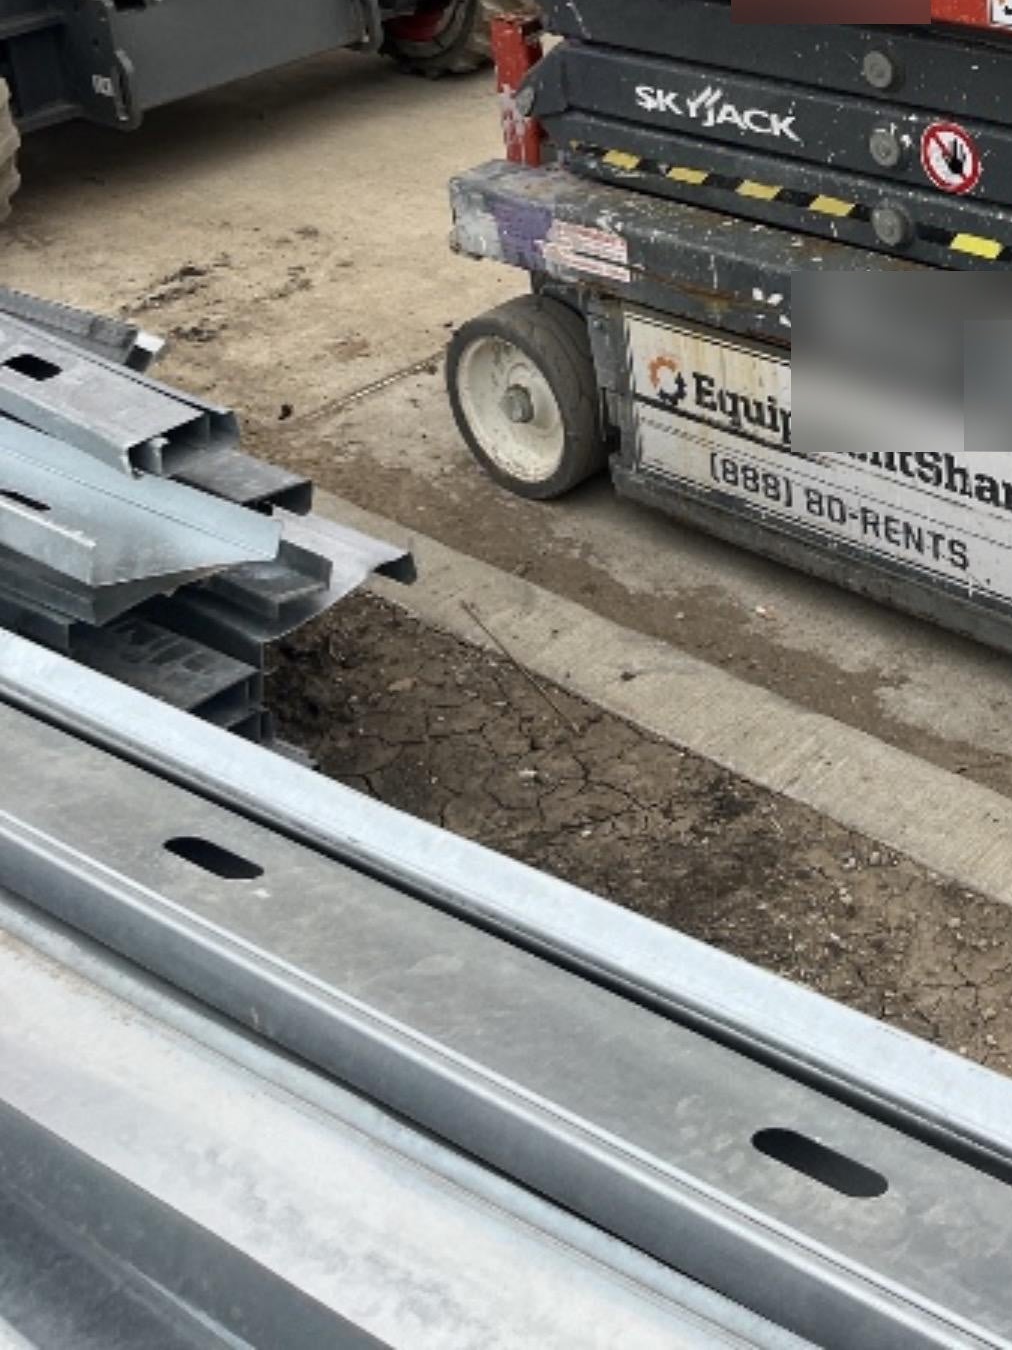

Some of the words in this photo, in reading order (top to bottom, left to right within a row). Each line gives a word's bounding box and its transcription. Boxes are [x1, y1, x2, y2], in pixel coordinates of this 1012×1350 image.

[634, 85, 801, 142] SKYJACK
[710, 451, 794, 508] (888)
[804, 487, 969, 570] 80-RENTS
